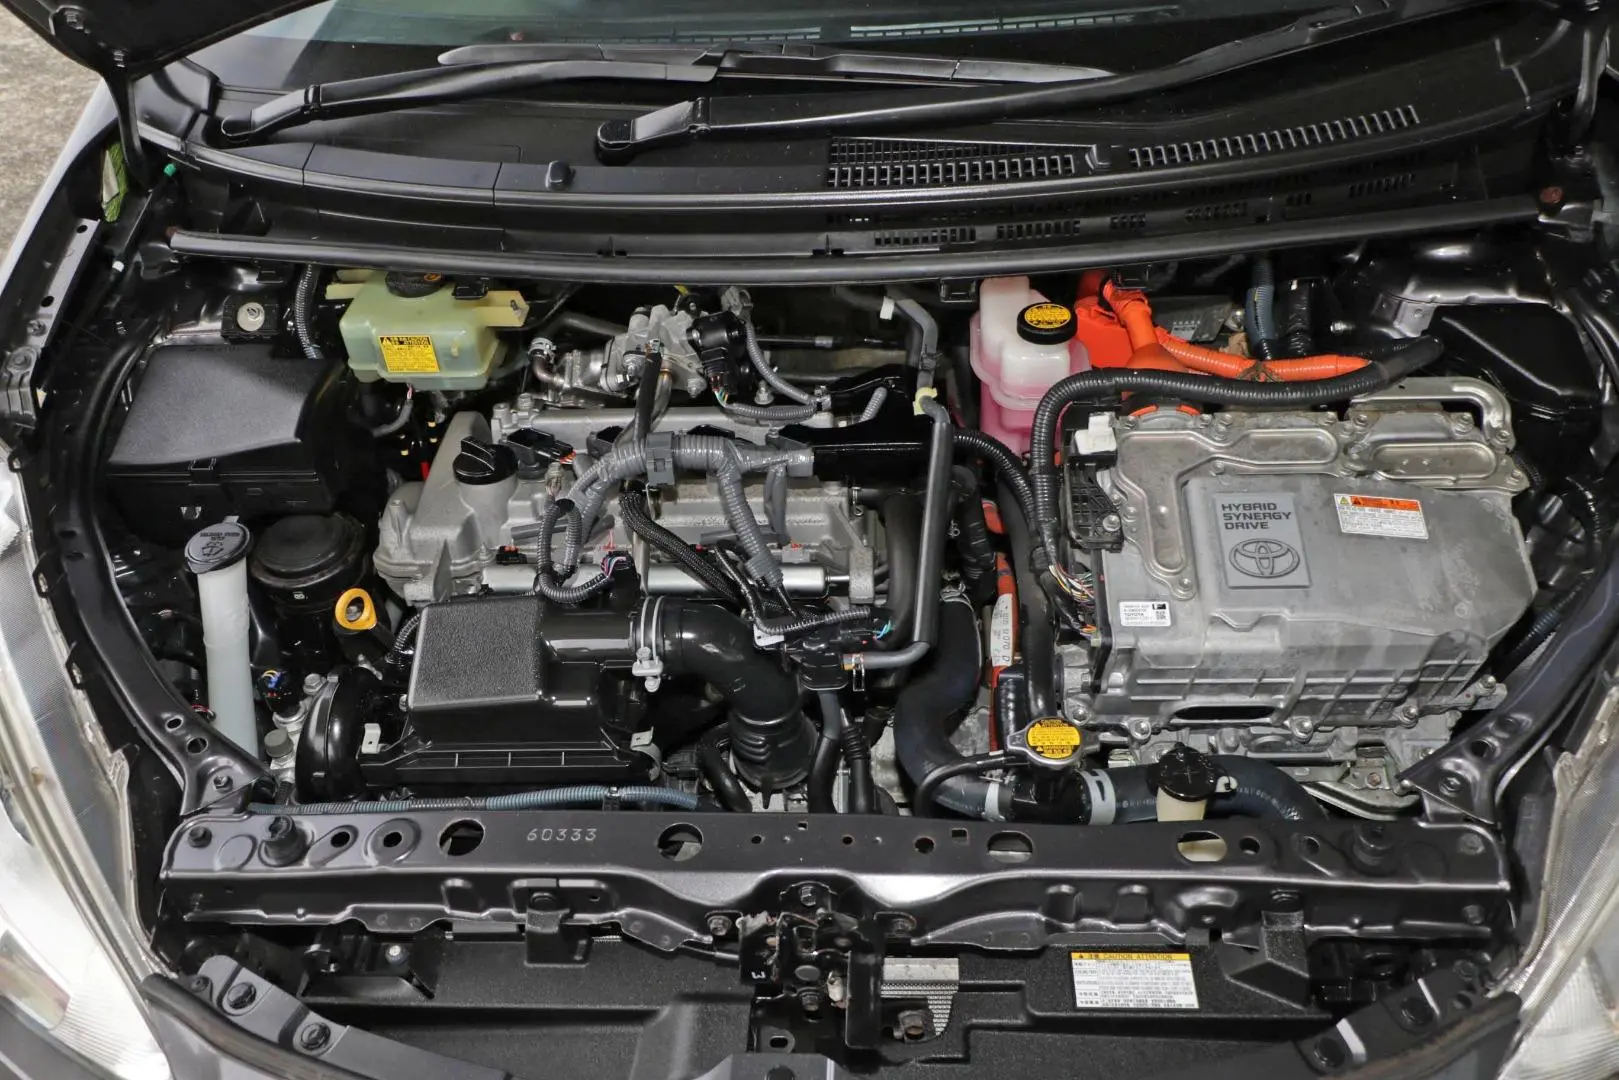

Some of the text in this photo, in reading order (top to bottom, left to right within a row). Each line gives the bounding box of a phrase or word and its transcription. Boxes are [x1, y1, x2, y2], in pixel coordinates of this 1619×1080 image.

[1221, 502, 1277, 511] HYBRID
[1223, 511, 1292, 520] SYNERGY
[1224, 521, 1270, 530] DRIVE
[526, 828, 597, 841] 60333
